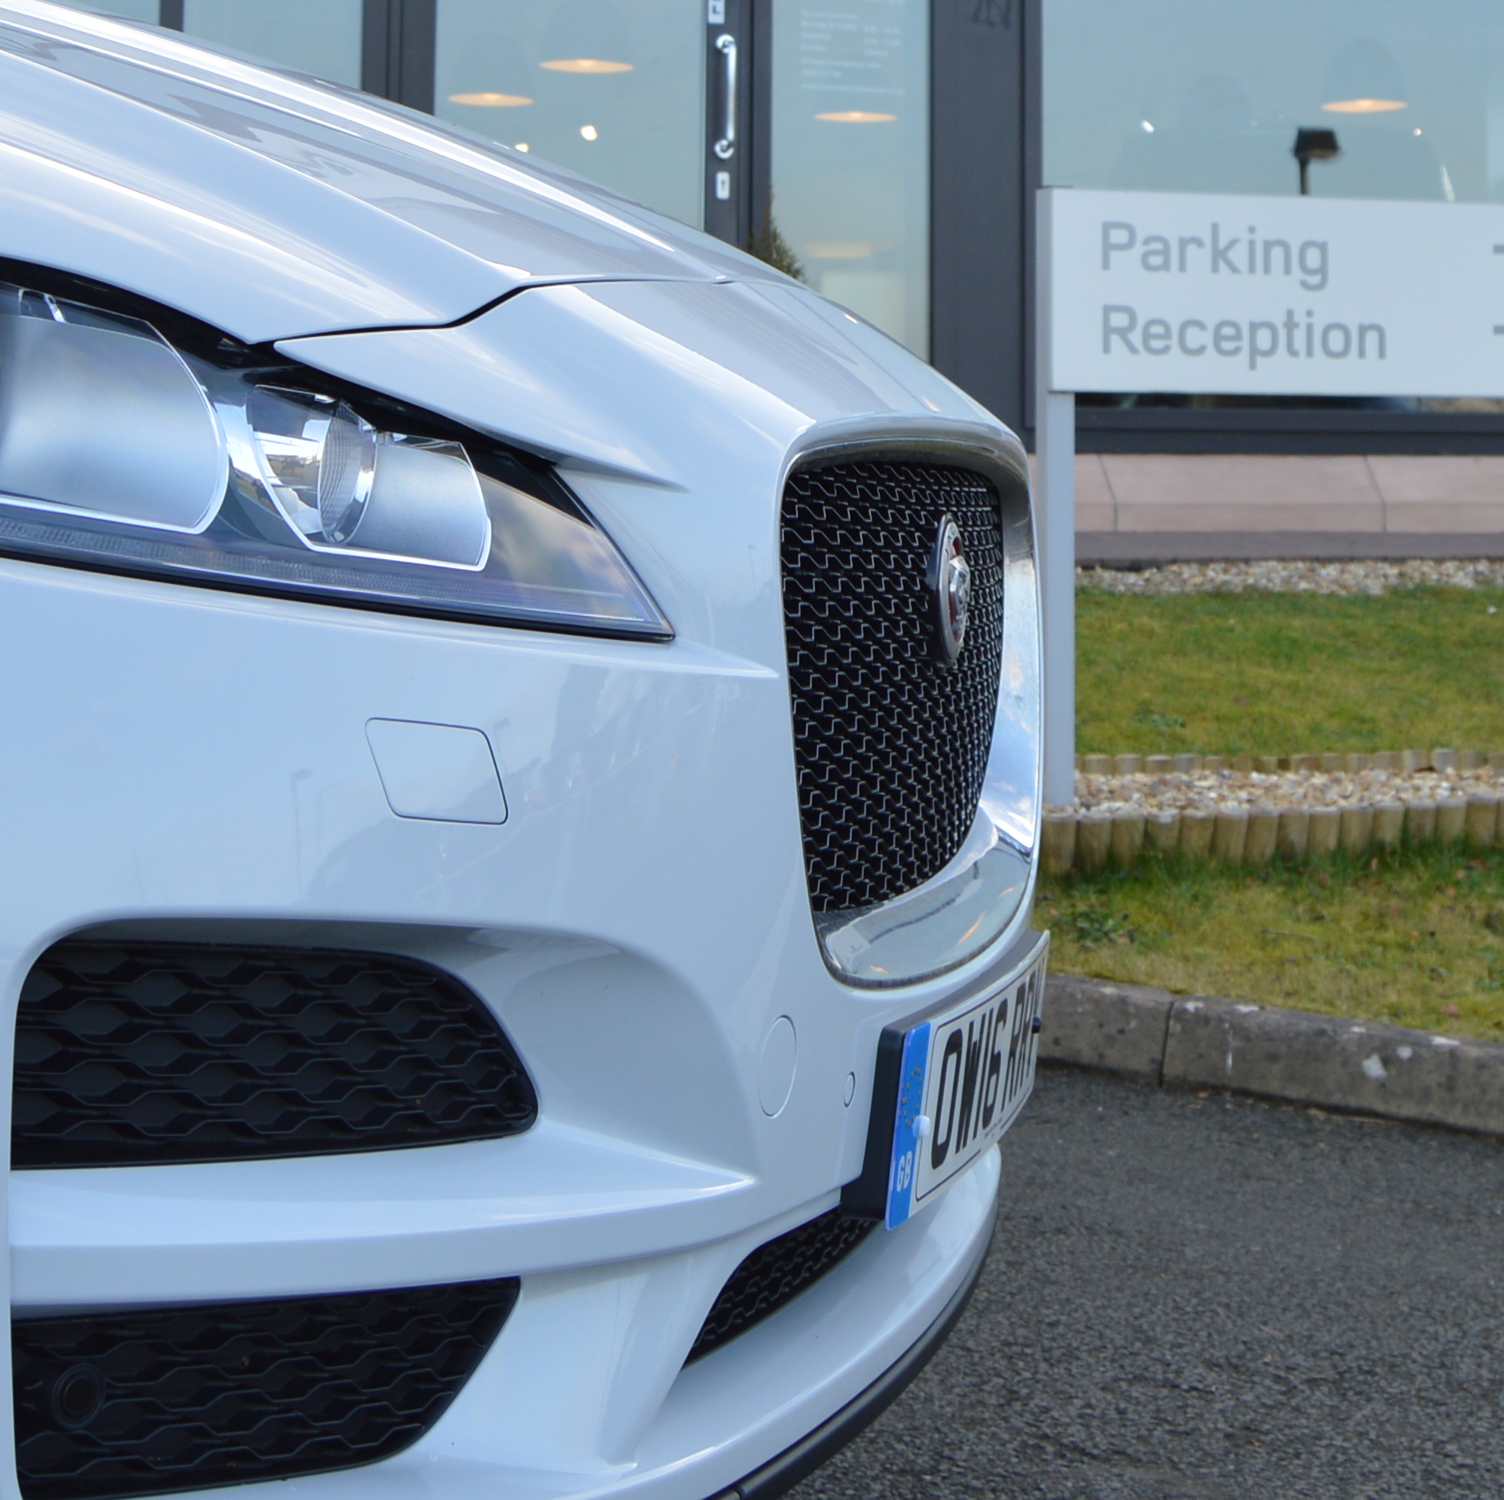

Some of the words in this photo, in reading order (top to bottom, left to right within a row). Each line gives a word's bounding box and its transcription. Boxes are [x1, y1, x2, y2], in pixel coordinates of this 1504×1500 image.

[1101, 220, 1330, 292] Parking
[1101, 304, 1388, 371] Reception
[896, 1150, 913, 1193] GB
